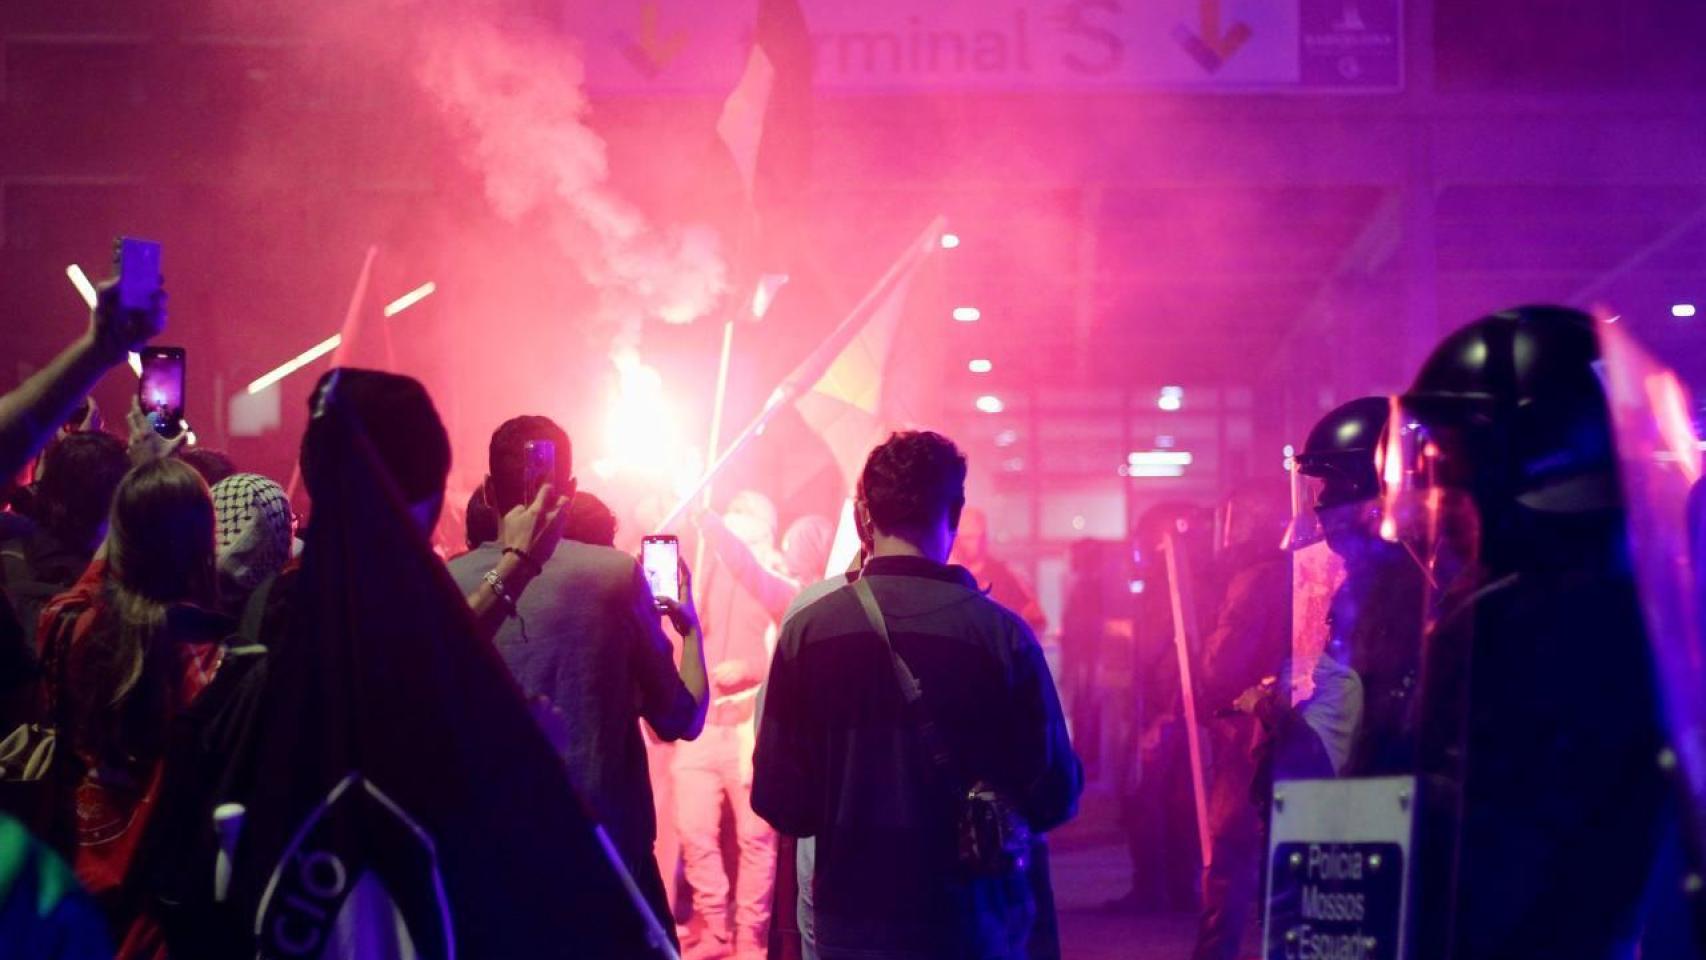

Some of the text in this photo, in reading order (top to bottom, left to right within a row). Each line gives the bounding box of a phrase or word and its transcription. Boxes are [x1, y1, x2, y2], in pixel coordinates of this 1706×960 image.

[738, 0, 1125, 76] rminal S
[1302, 884, 1365, 921] Mossos
